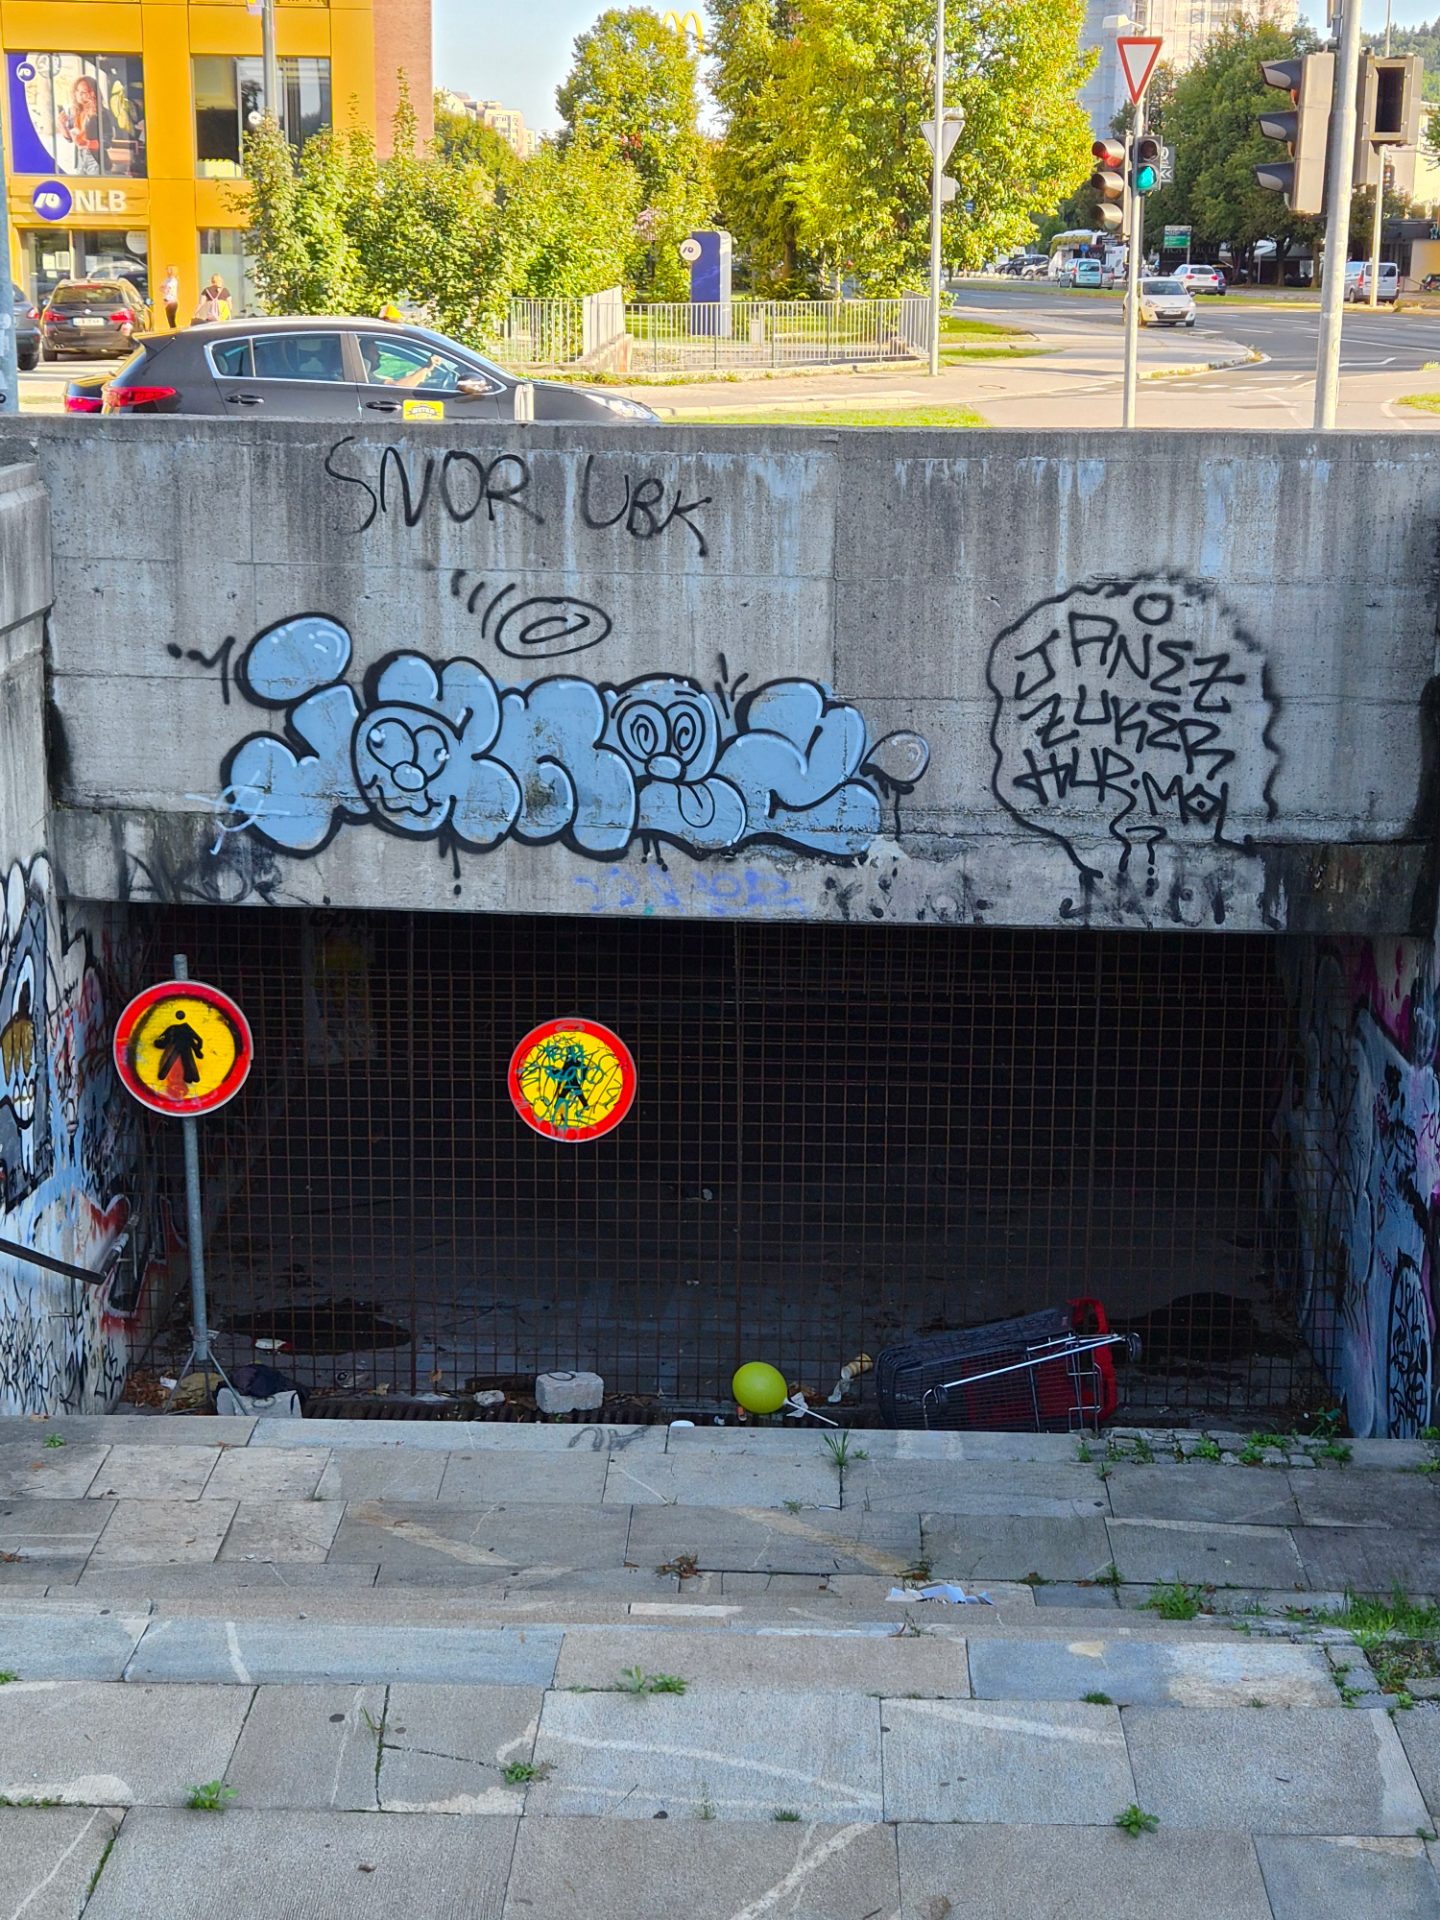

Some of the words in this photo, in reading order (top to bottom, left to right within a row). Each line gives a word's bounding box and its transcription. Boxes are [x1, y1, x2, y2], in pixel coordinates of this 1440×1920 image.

[75, 189, 127, 212] NLB
[324, 435, 546, 534] SNOR
[580, 453, 713, 558] UBK
[1014, 611, 1246, 713] JANEZ
[1018, 684, 1236, 780] ZUKER
